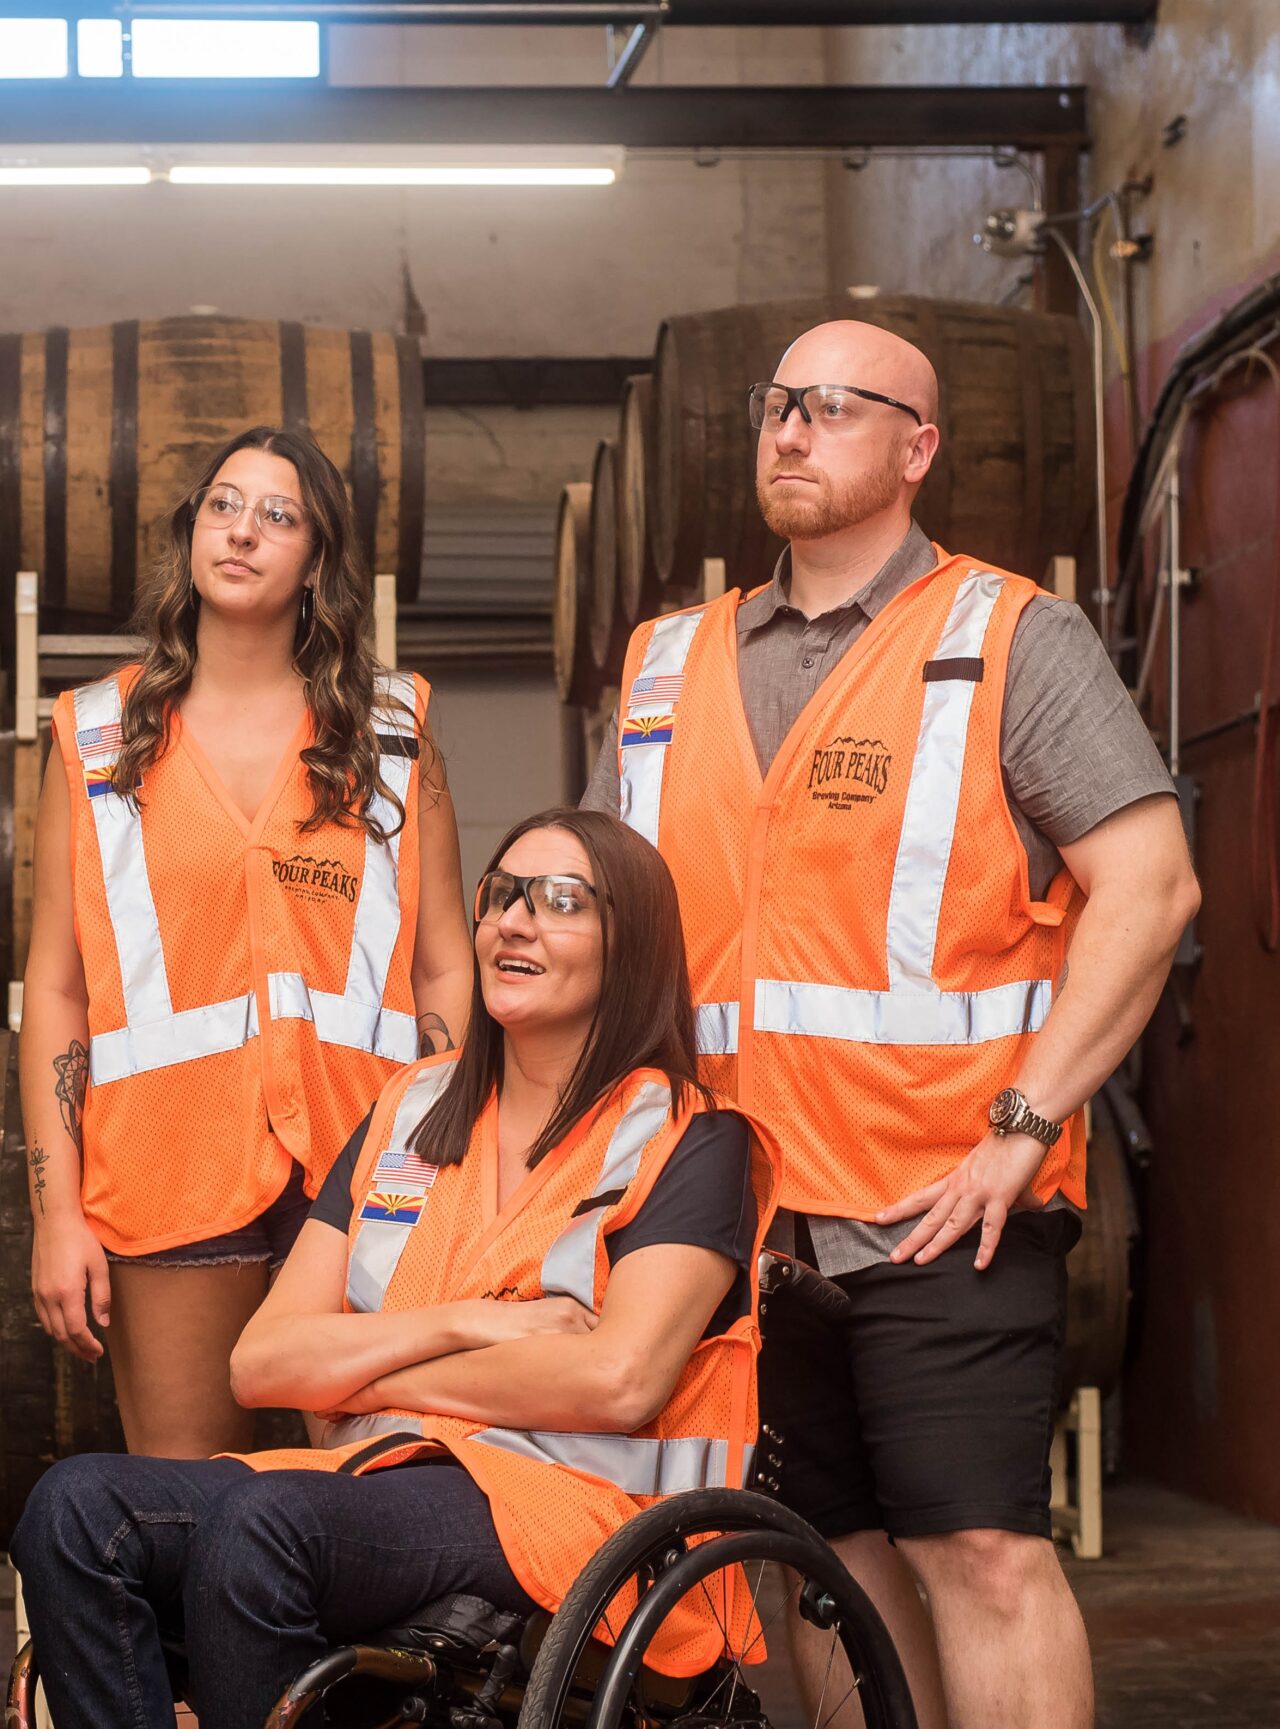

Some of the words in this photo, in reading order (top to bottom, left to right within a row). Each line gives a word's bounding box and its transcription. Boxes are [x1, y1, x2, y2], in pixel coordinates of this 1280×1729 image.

[807, 749, 845, 789] FOUR
[845, 751, 892, 795] PEAKS
[812, 791, 840, 801] Brewing
[841, 791, 875, 804] Company
[828, 801, 852, 811] Arizona
[272, 860, 310, 884] FOUR
[310, 869, 358, 903] PEAKS
